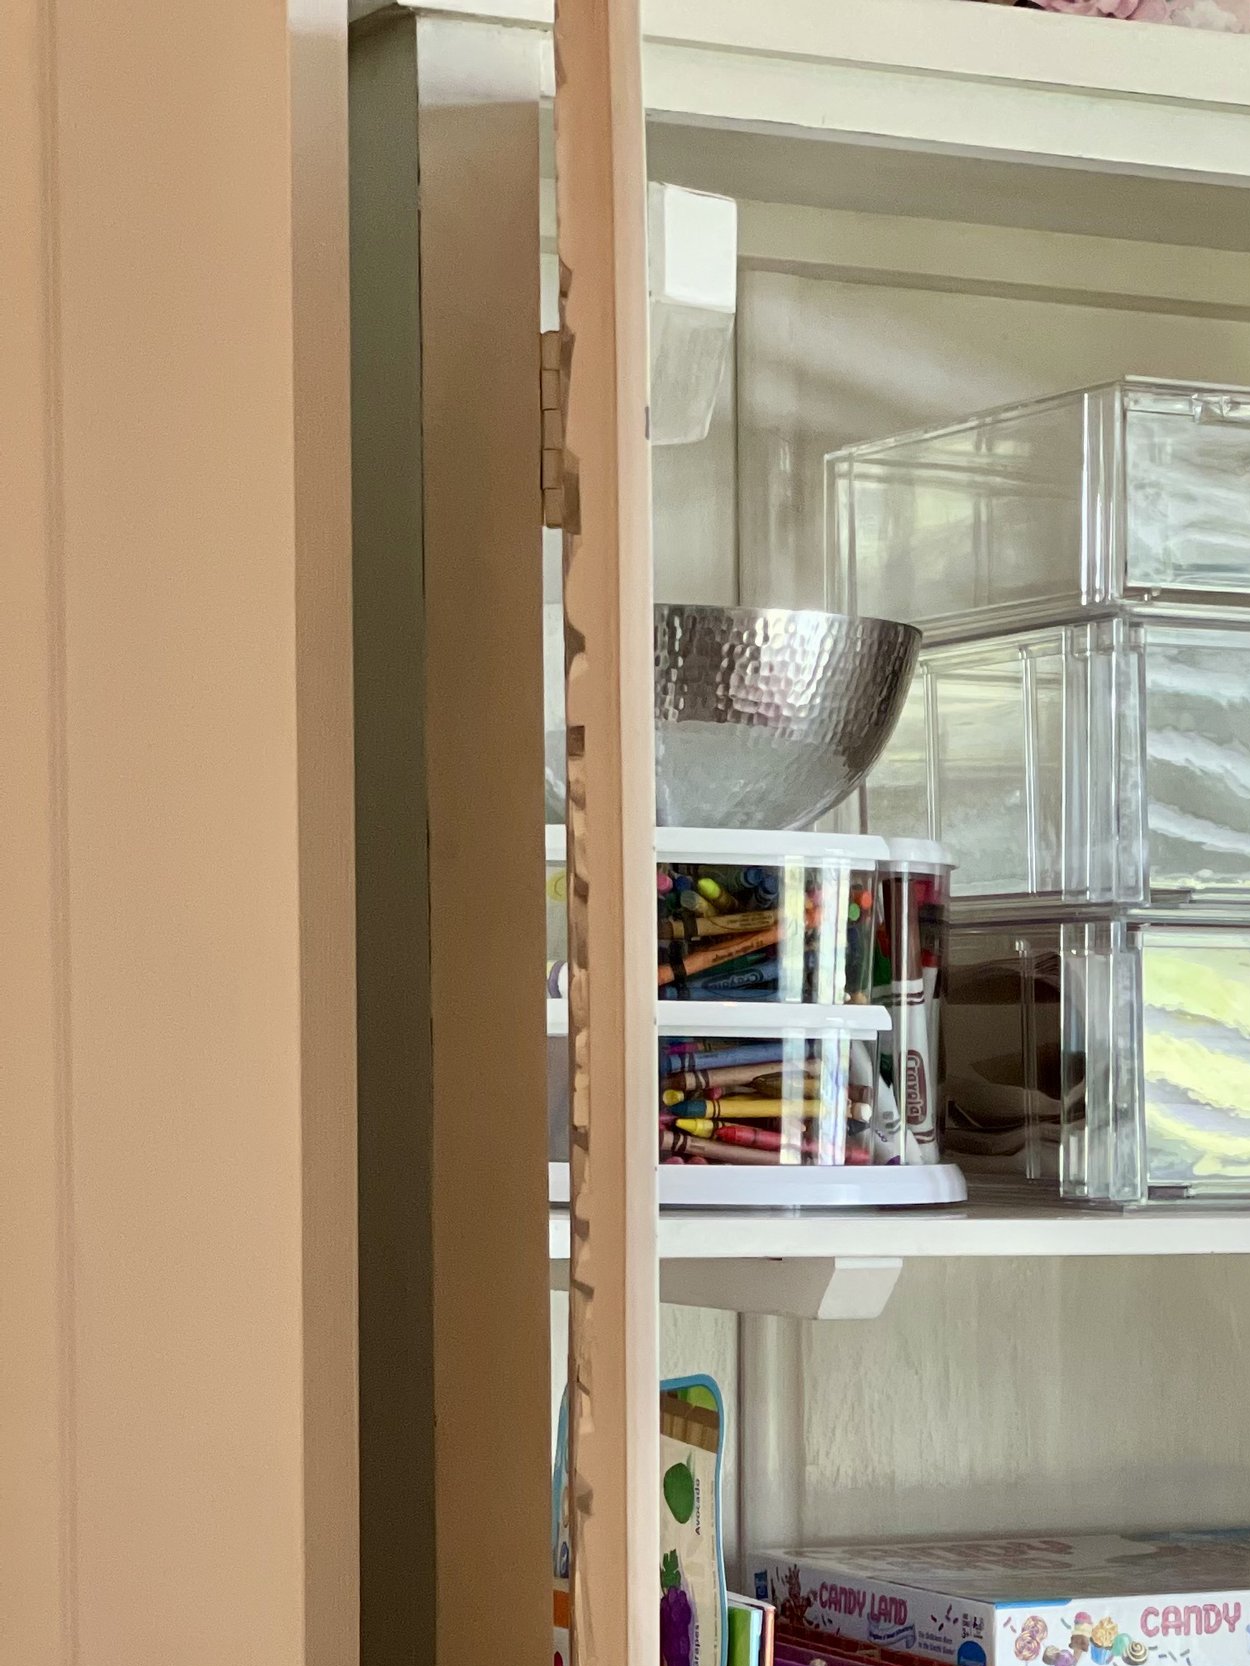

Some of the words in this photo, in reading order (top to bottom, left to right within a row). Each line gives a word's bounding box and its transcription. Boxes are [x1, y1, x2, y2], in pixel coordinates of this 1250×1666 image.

[906, 1053, 920, 1124] Crayola
[818, 1581, 867, 1618] CANDY
[869, 1591, 908, 1626] LAND
[1140, 1602, 1242, 1638] CANDY
